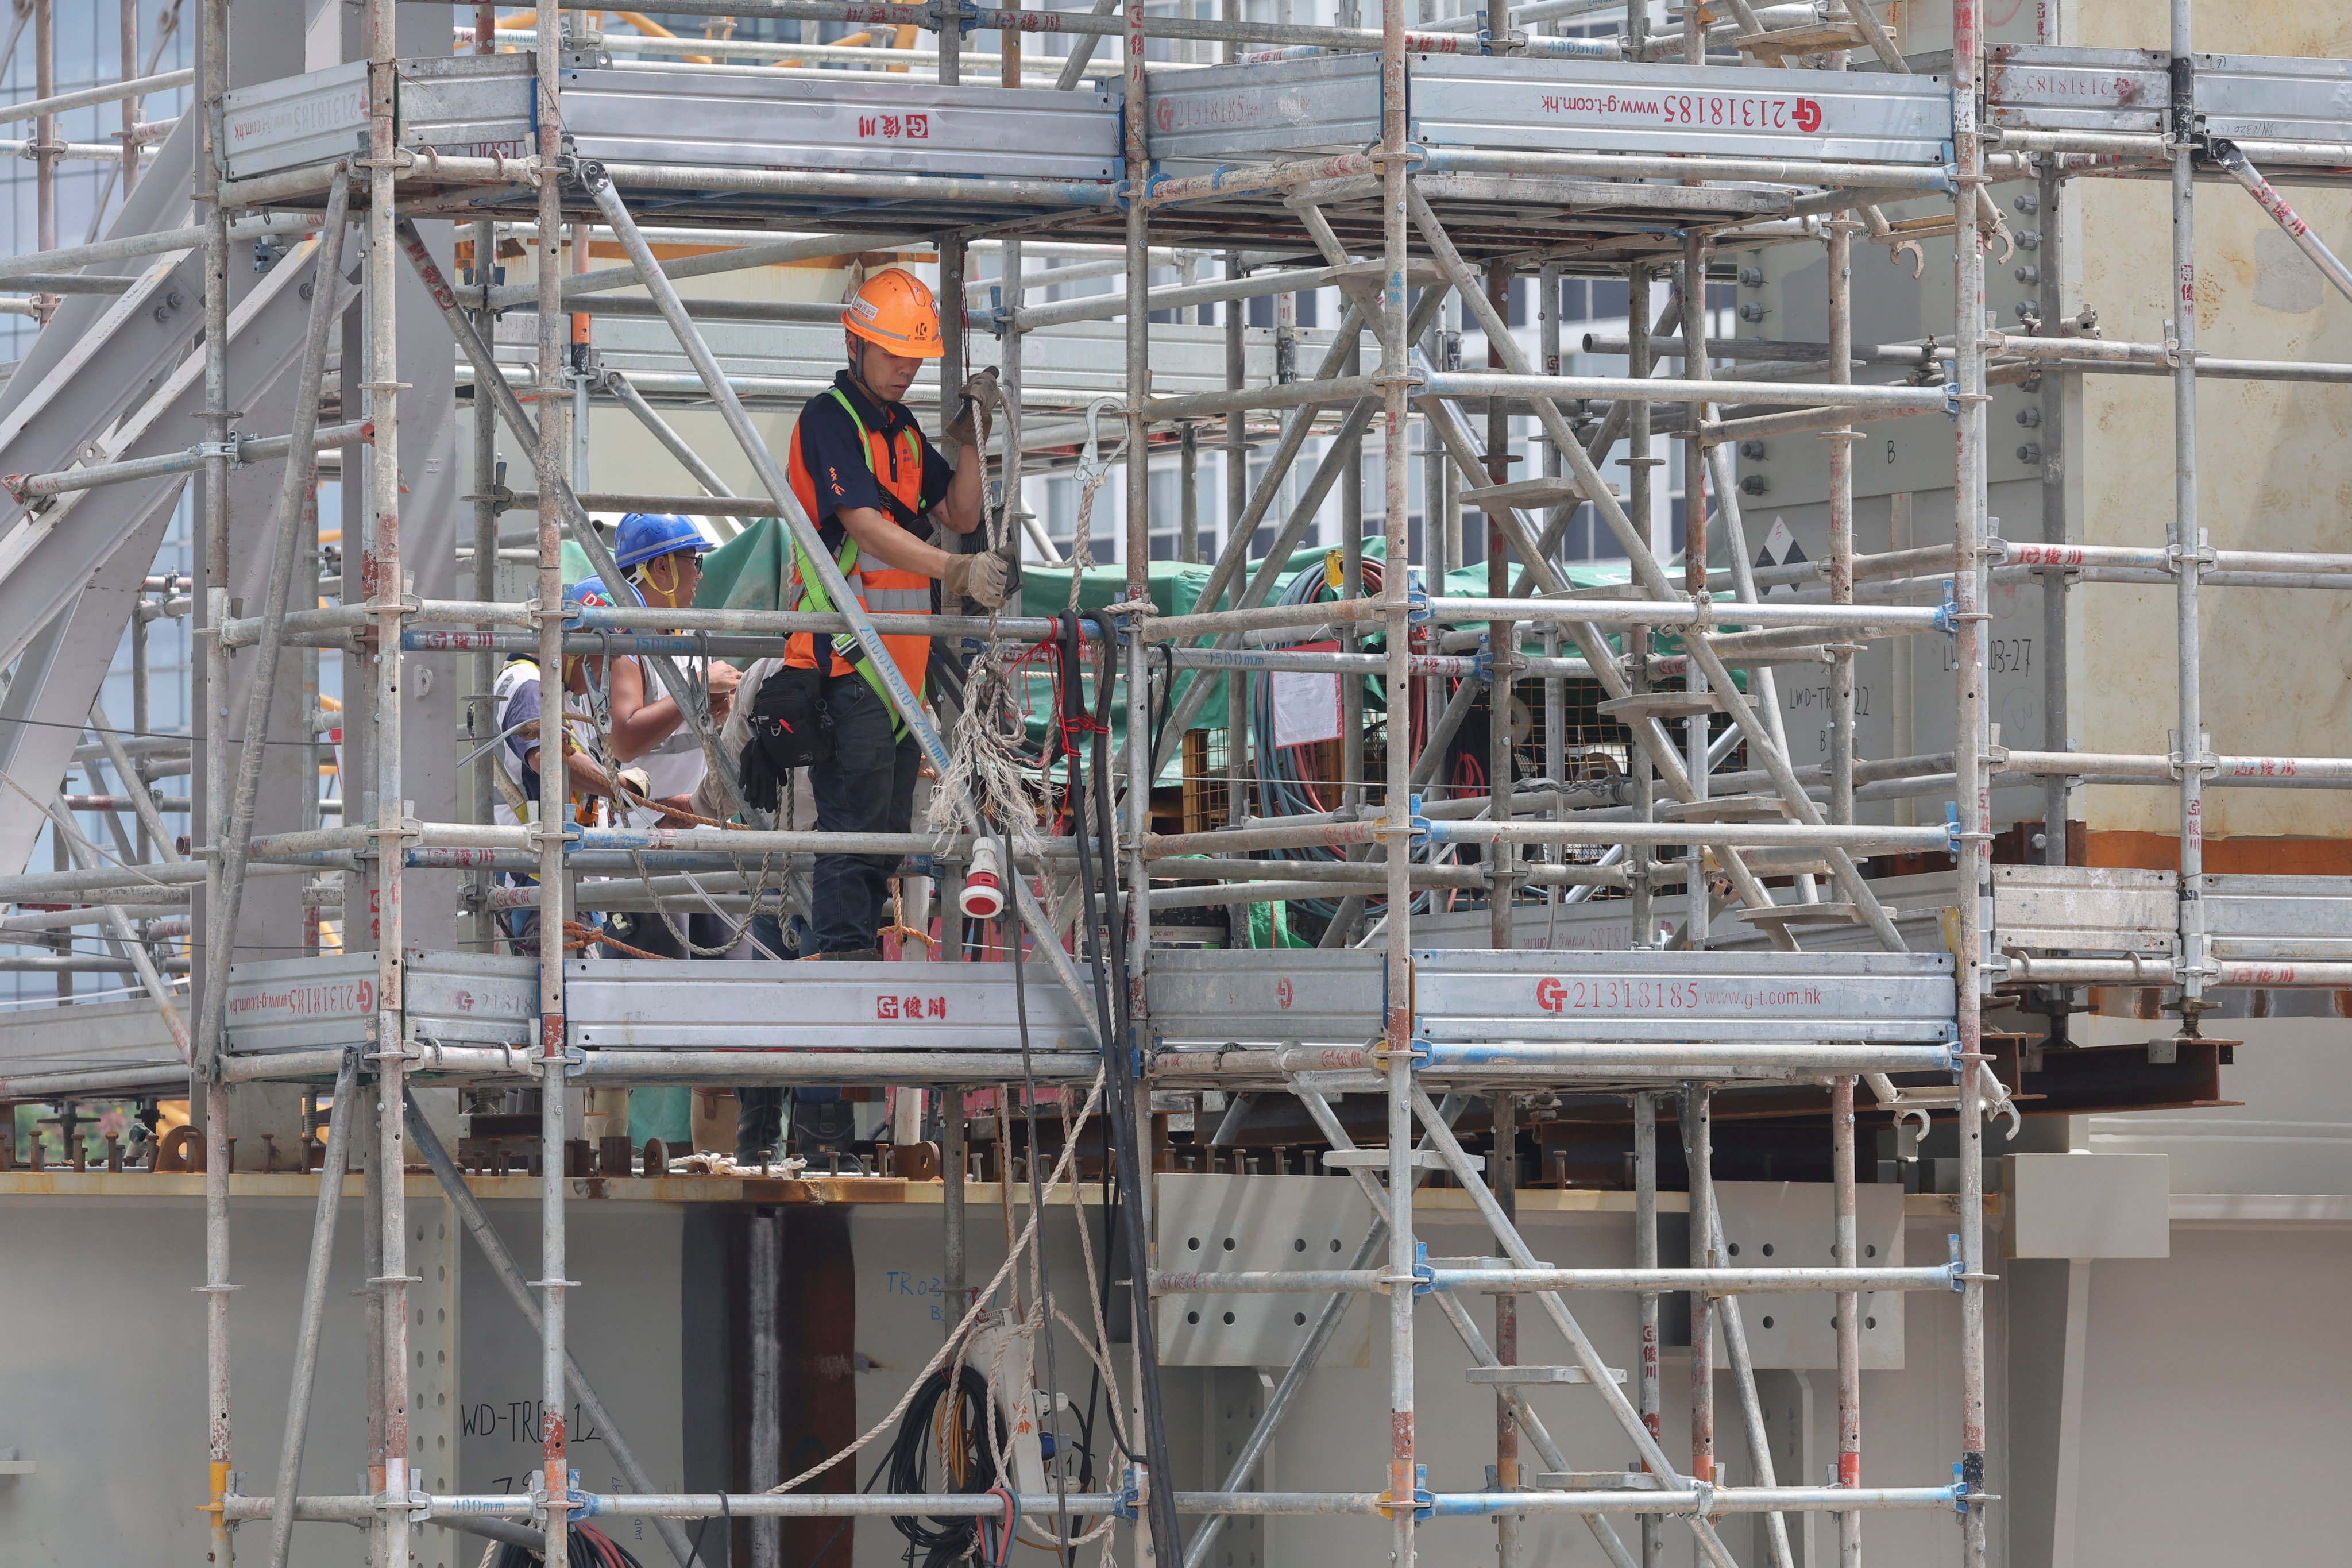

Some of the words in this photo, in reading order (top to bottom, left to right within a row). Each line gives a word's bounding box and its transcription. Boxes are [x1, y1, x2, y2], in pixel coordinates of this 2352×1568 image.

[1177, 95, 1245, 126] 21318185
[1542, 95, 1659, 114] www.g-t.com.hk
[1664, 95, 1786, 129] 21318185
[859, 115, 901, 138] 俊川
[1888, 440, 1895, 464] B
[1210, 652, 1264, 665] 1500mm
[1820, 730, 1826, 752] B
[289, 984, 354, 1015] 21318185
[903, 996, 946, 1019] 俊川
[1573, 982, 1698, 1010] 21318185
[1705, 988, 1821, 1010] www.g-t.com.hk
